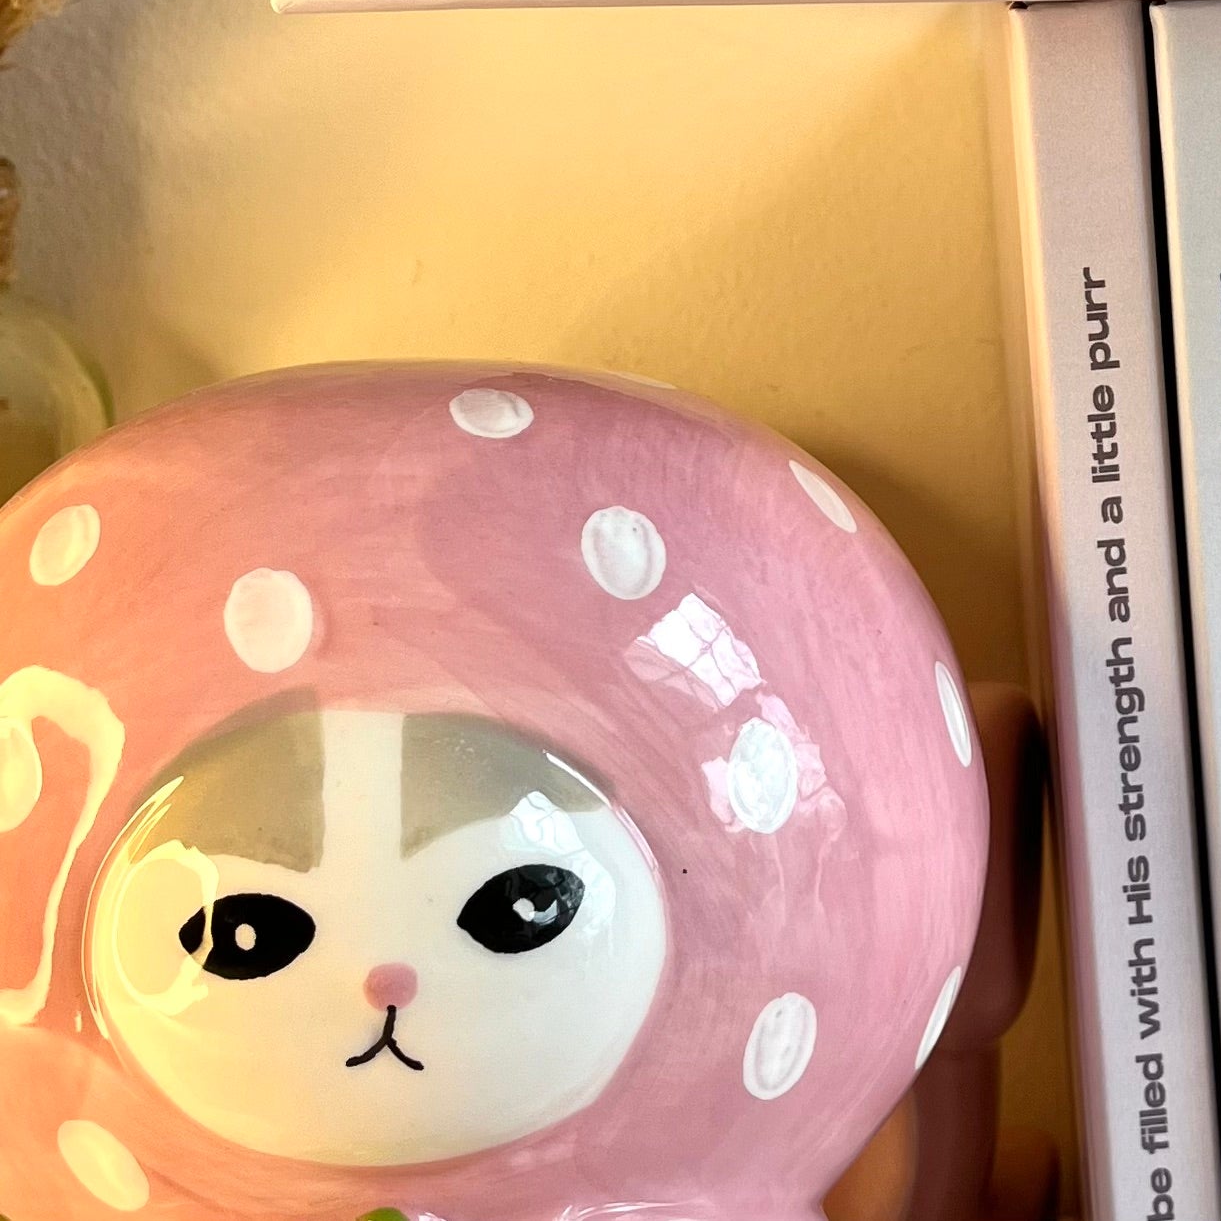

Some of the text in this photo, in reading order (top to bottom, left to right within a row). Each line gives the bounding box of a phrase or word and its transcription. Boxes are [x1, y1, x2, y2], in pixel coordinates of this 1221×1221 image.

[1083, 266, 1174, 1221] be filled with His strength and a little purr
